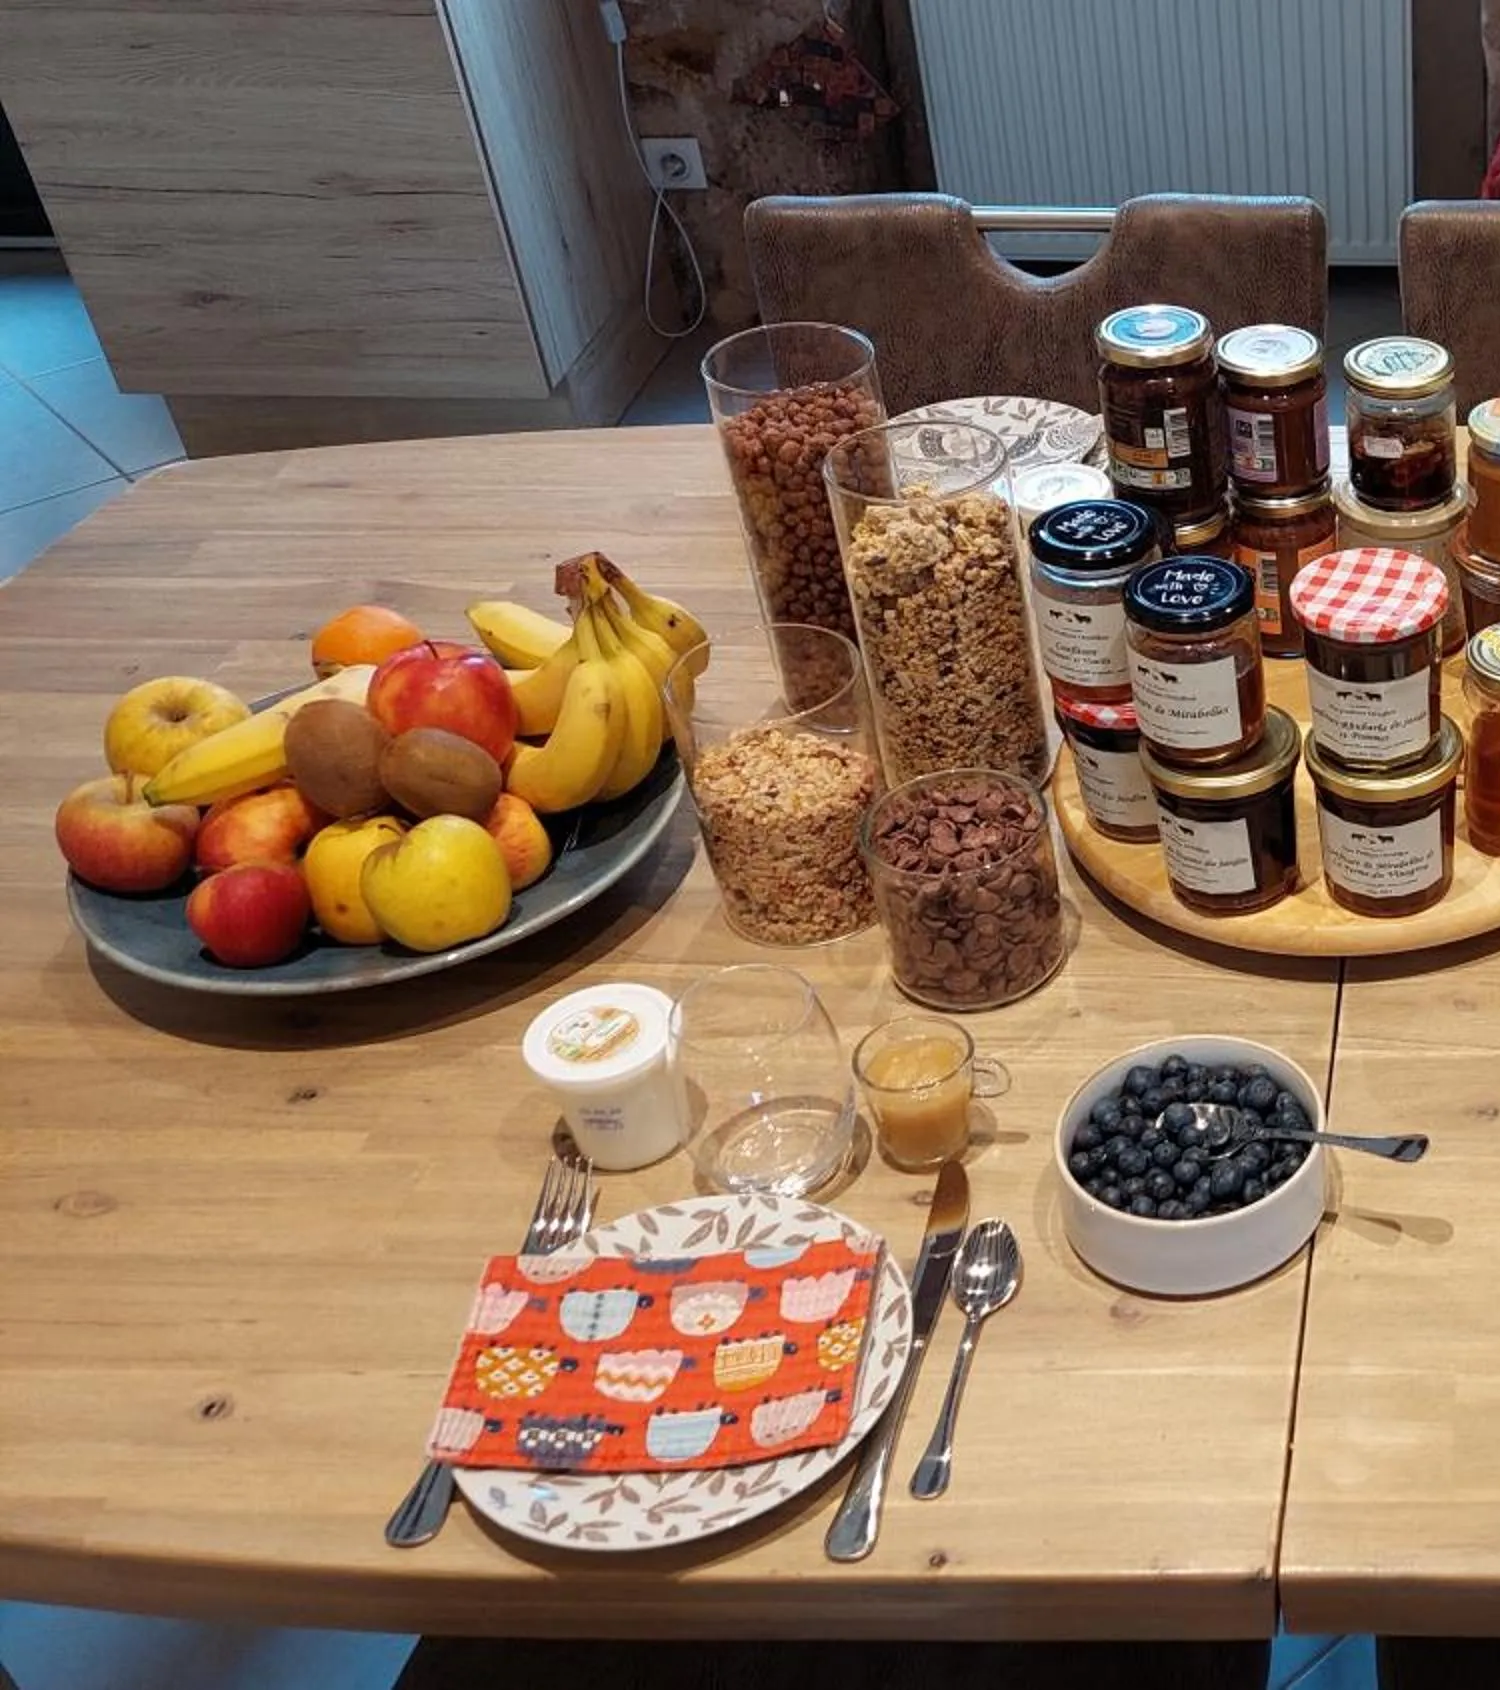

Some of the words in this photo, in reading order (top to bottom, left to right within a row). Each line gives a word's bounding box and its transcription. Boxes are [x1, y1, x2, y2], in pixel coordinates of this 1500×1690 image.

[1055, 509, 1097, 533] Made
[1092, 520, 1129, 541] Love
[1163, 569, 1215, 583] Made
[1153, 582, 1183, 592] with
[1160, 591, 1204, 605] Love
